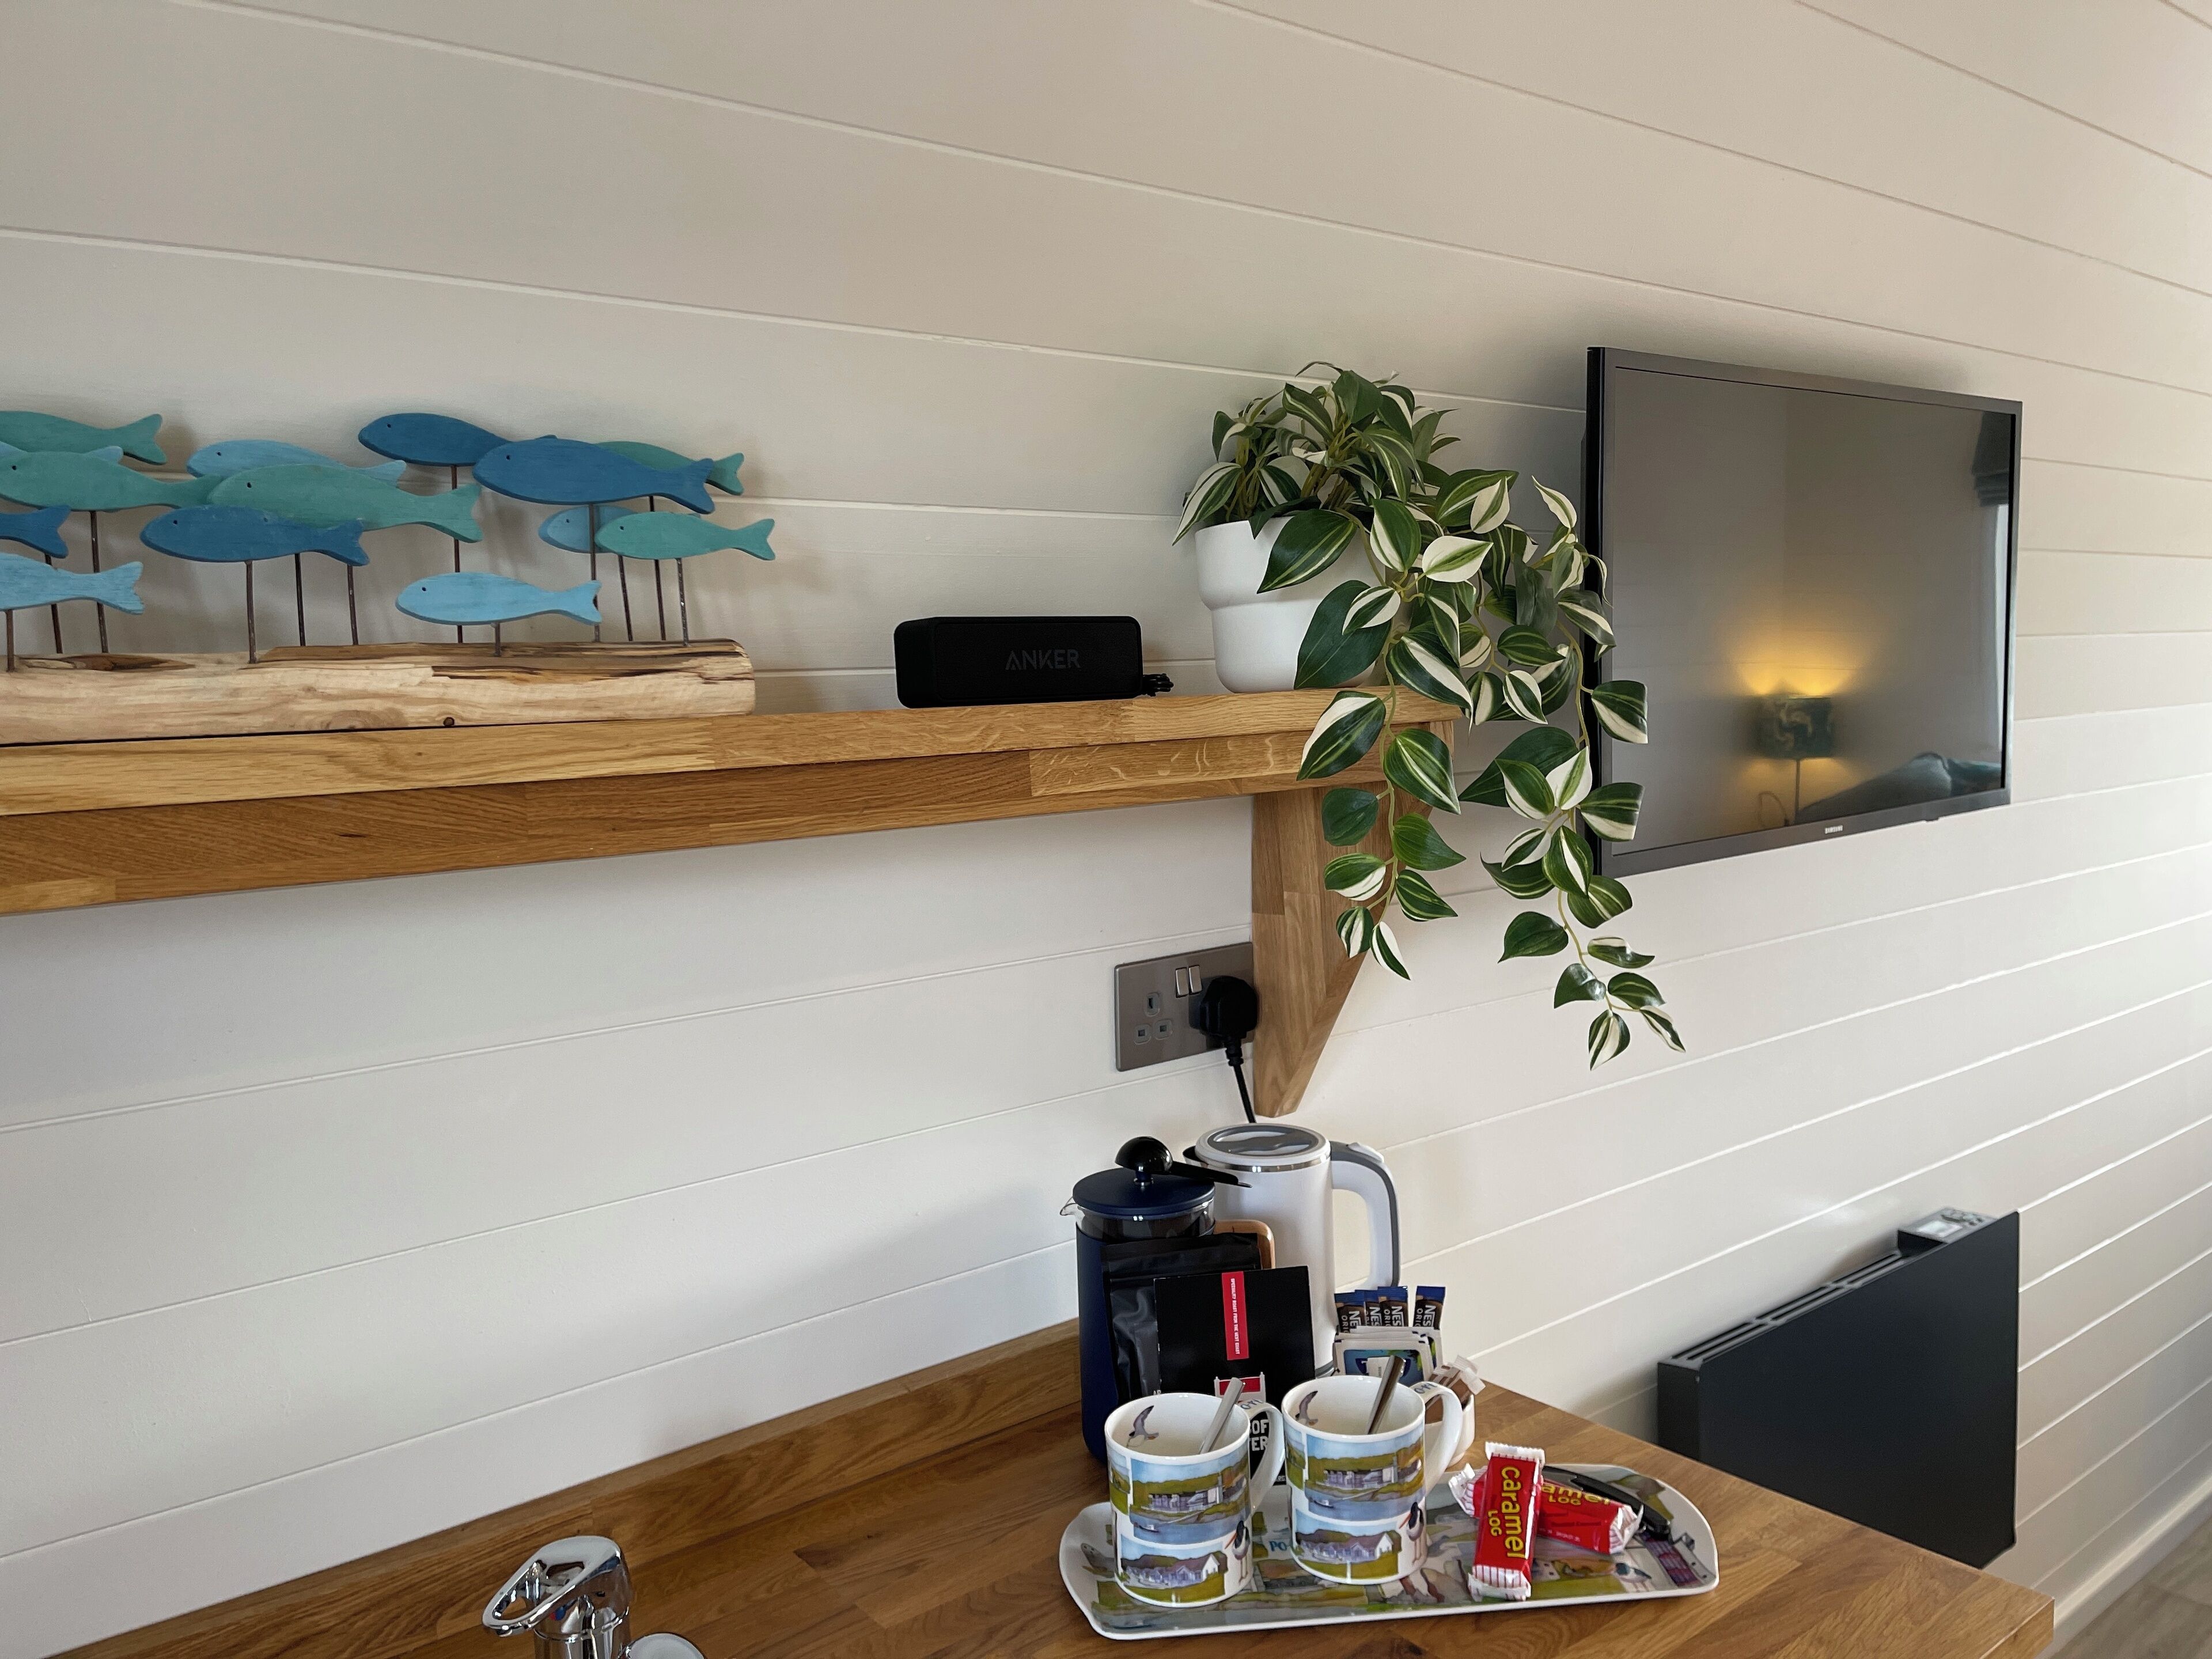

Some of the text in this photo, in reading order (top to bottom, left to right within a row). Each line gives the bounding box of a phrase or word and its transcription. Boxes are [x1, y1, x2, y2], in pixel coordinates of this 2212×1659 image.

[1005, 649, 1081, 670] ANKER
[1249, 1419, 1270, 1434] OF
[1249, 1436, 1268, 1451] ER
[1488, 1510, 1502, 1536] LOG
